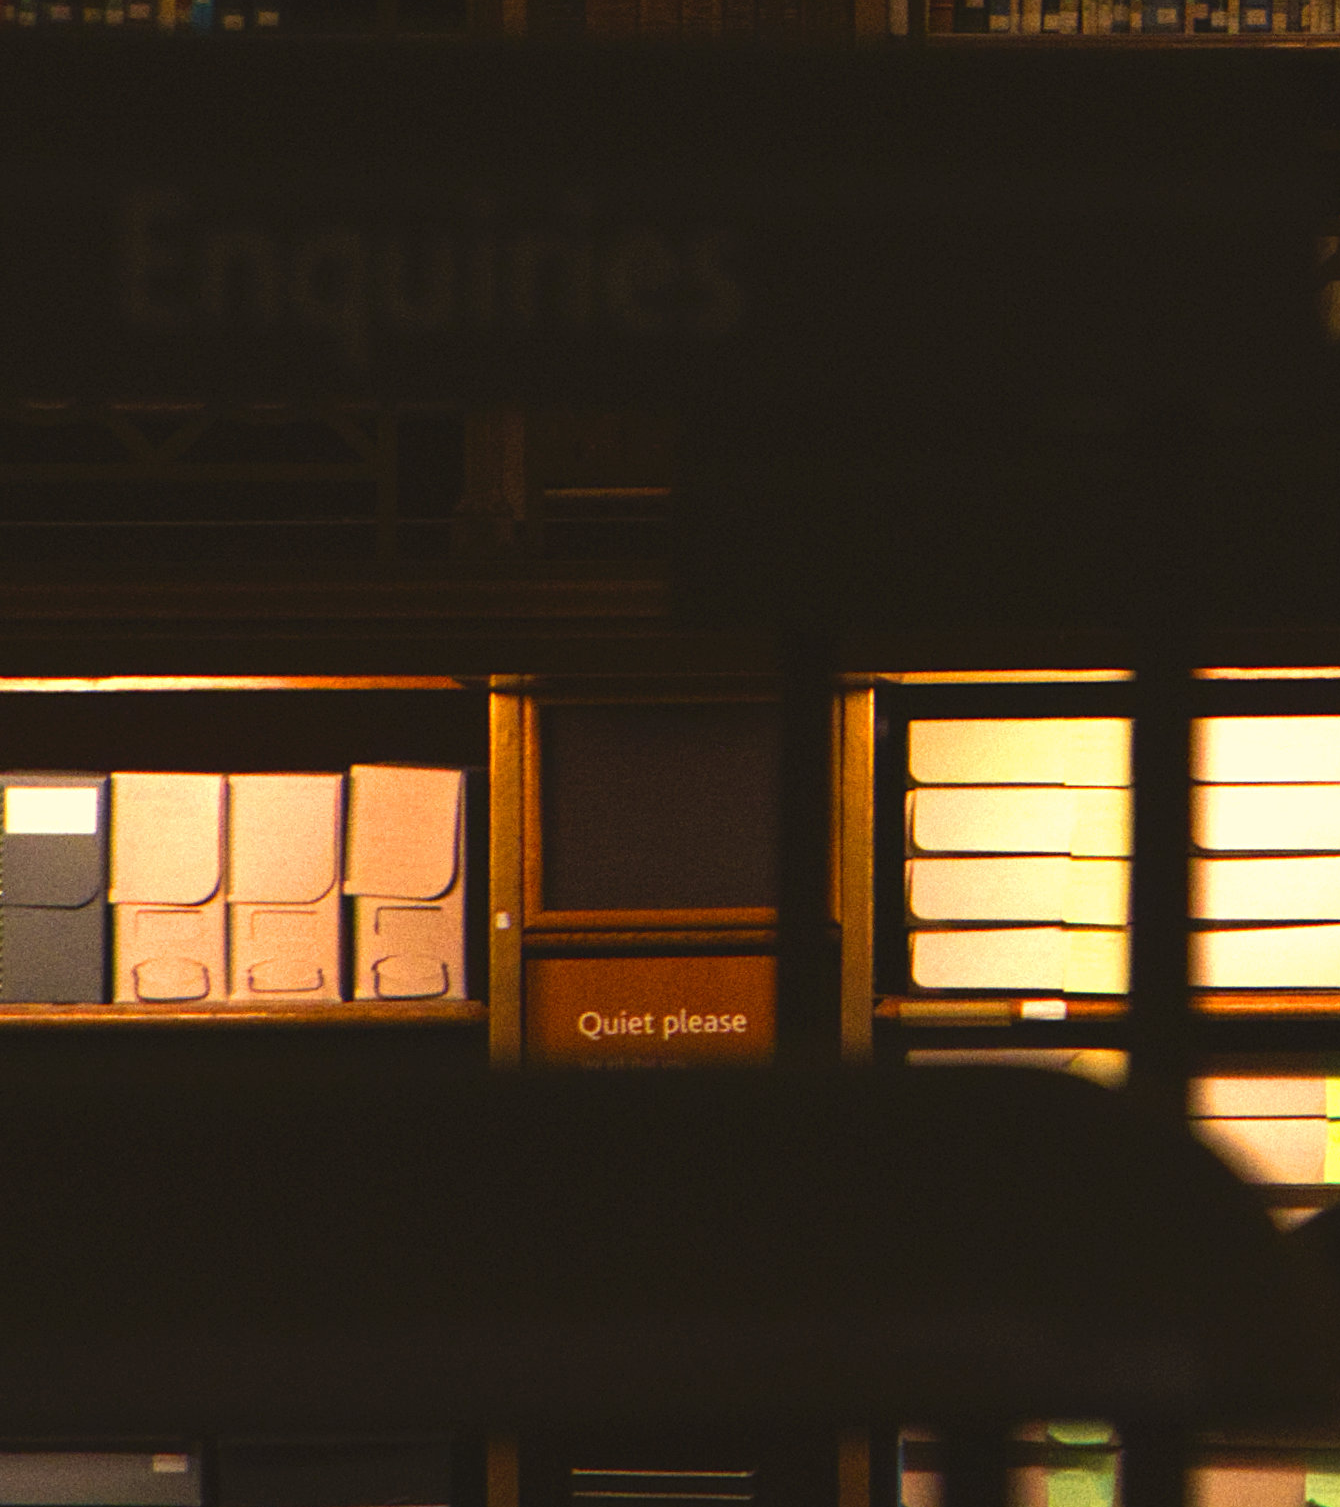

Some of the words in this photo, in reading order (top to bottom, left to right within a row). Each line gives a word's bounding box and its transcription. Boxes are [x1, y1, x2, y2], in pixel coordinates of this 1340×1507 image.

[116, 185, 744, 372] Enquiries
[577, 1010, 655, 1041] Quiet
[662, 1008, 748, 1041] please
